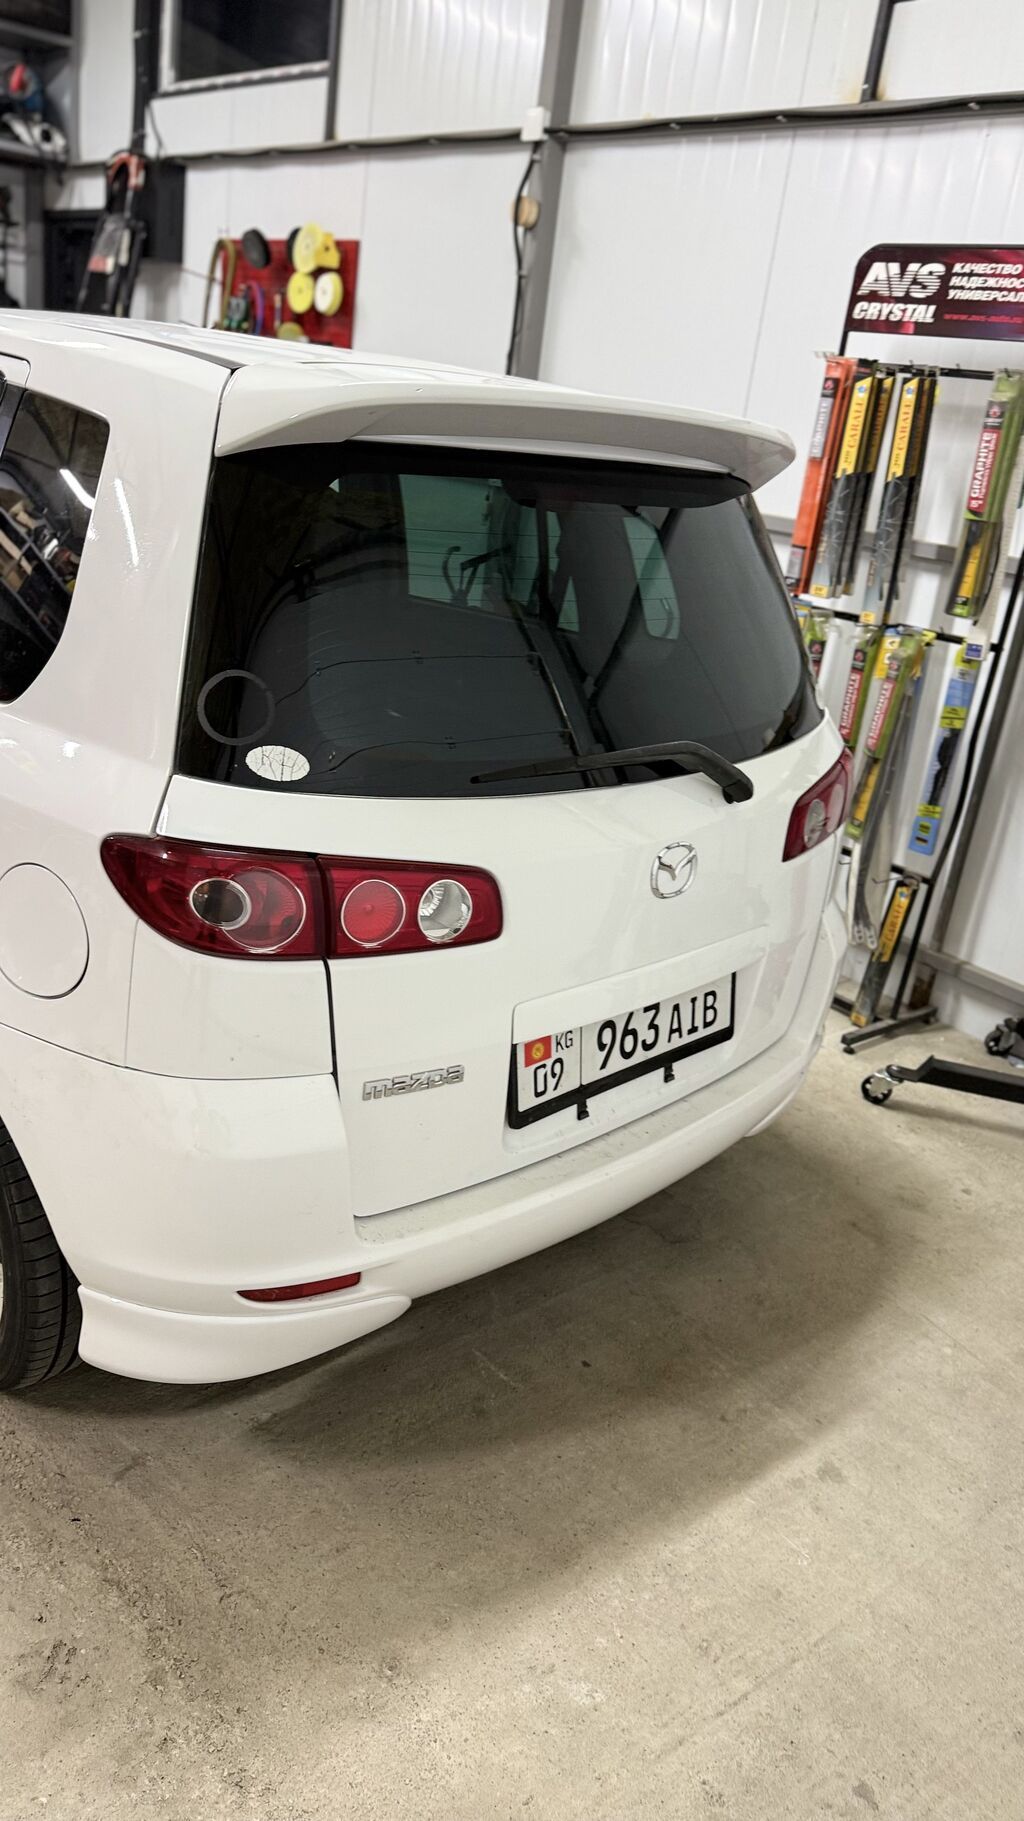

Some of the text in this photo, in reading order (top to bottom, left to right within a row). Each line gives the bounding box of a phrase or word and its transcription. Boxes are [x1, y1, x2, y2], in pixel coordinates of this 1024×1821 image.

[856, 261, 946, 298] AVS
[952, 262, 1023, 275] КАЧЕСТВО
[852, 301, 937, 323] CRYSTAL
[970, 432, 992, 498] GRAPHITE
[555, 1030, 574, 1053] KG
[597, 990, 717, 1071] 963 AIB
[533, 1057, 564, 1098] 09
